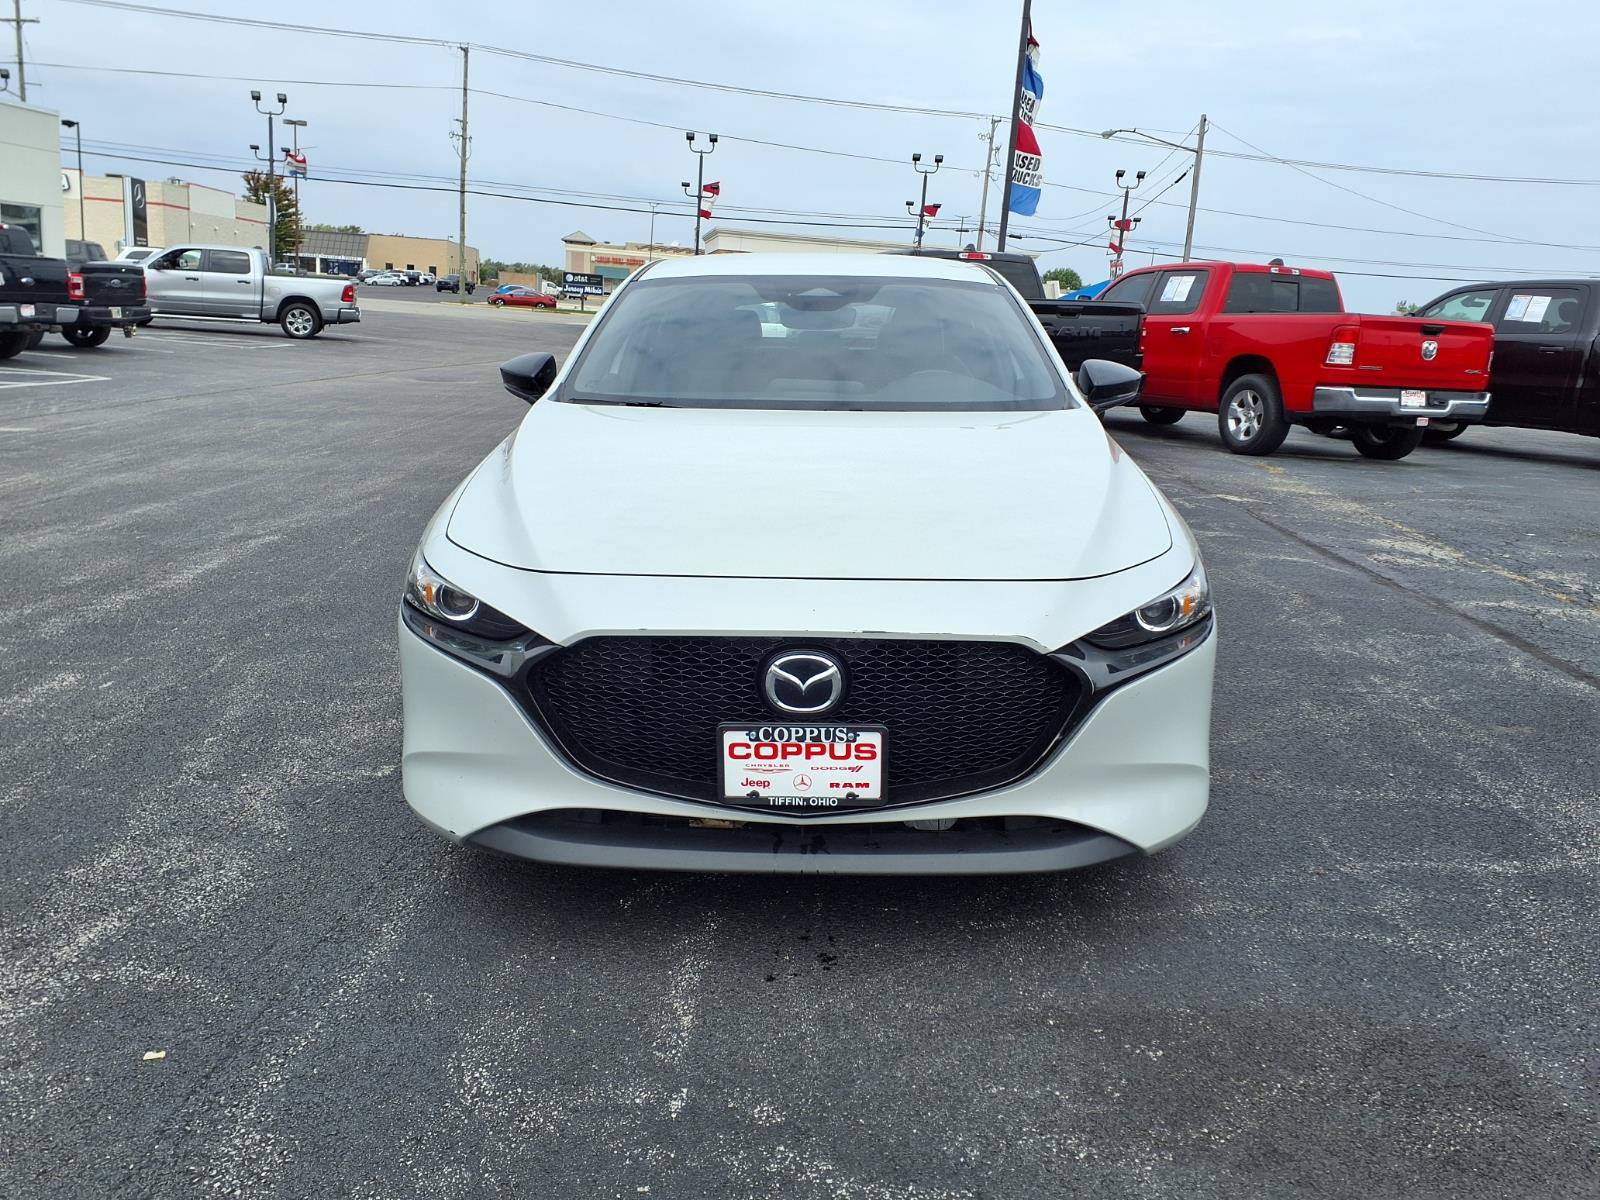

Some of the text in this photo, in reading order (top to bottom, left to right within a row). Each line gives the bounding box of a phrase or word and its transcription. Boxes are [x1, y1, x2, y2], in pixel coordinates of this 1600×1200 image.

[1015, 153, 1041, 171] USED
[1012, 168, 1043, 188] RUCKS
[758, 727, 847, 743] COPPUS
[728, 742, 877, 760] COPPUS
[741, 778, 771, 789] Jeep
[768, 797, 838, 806] TIFFIN, OHIO
